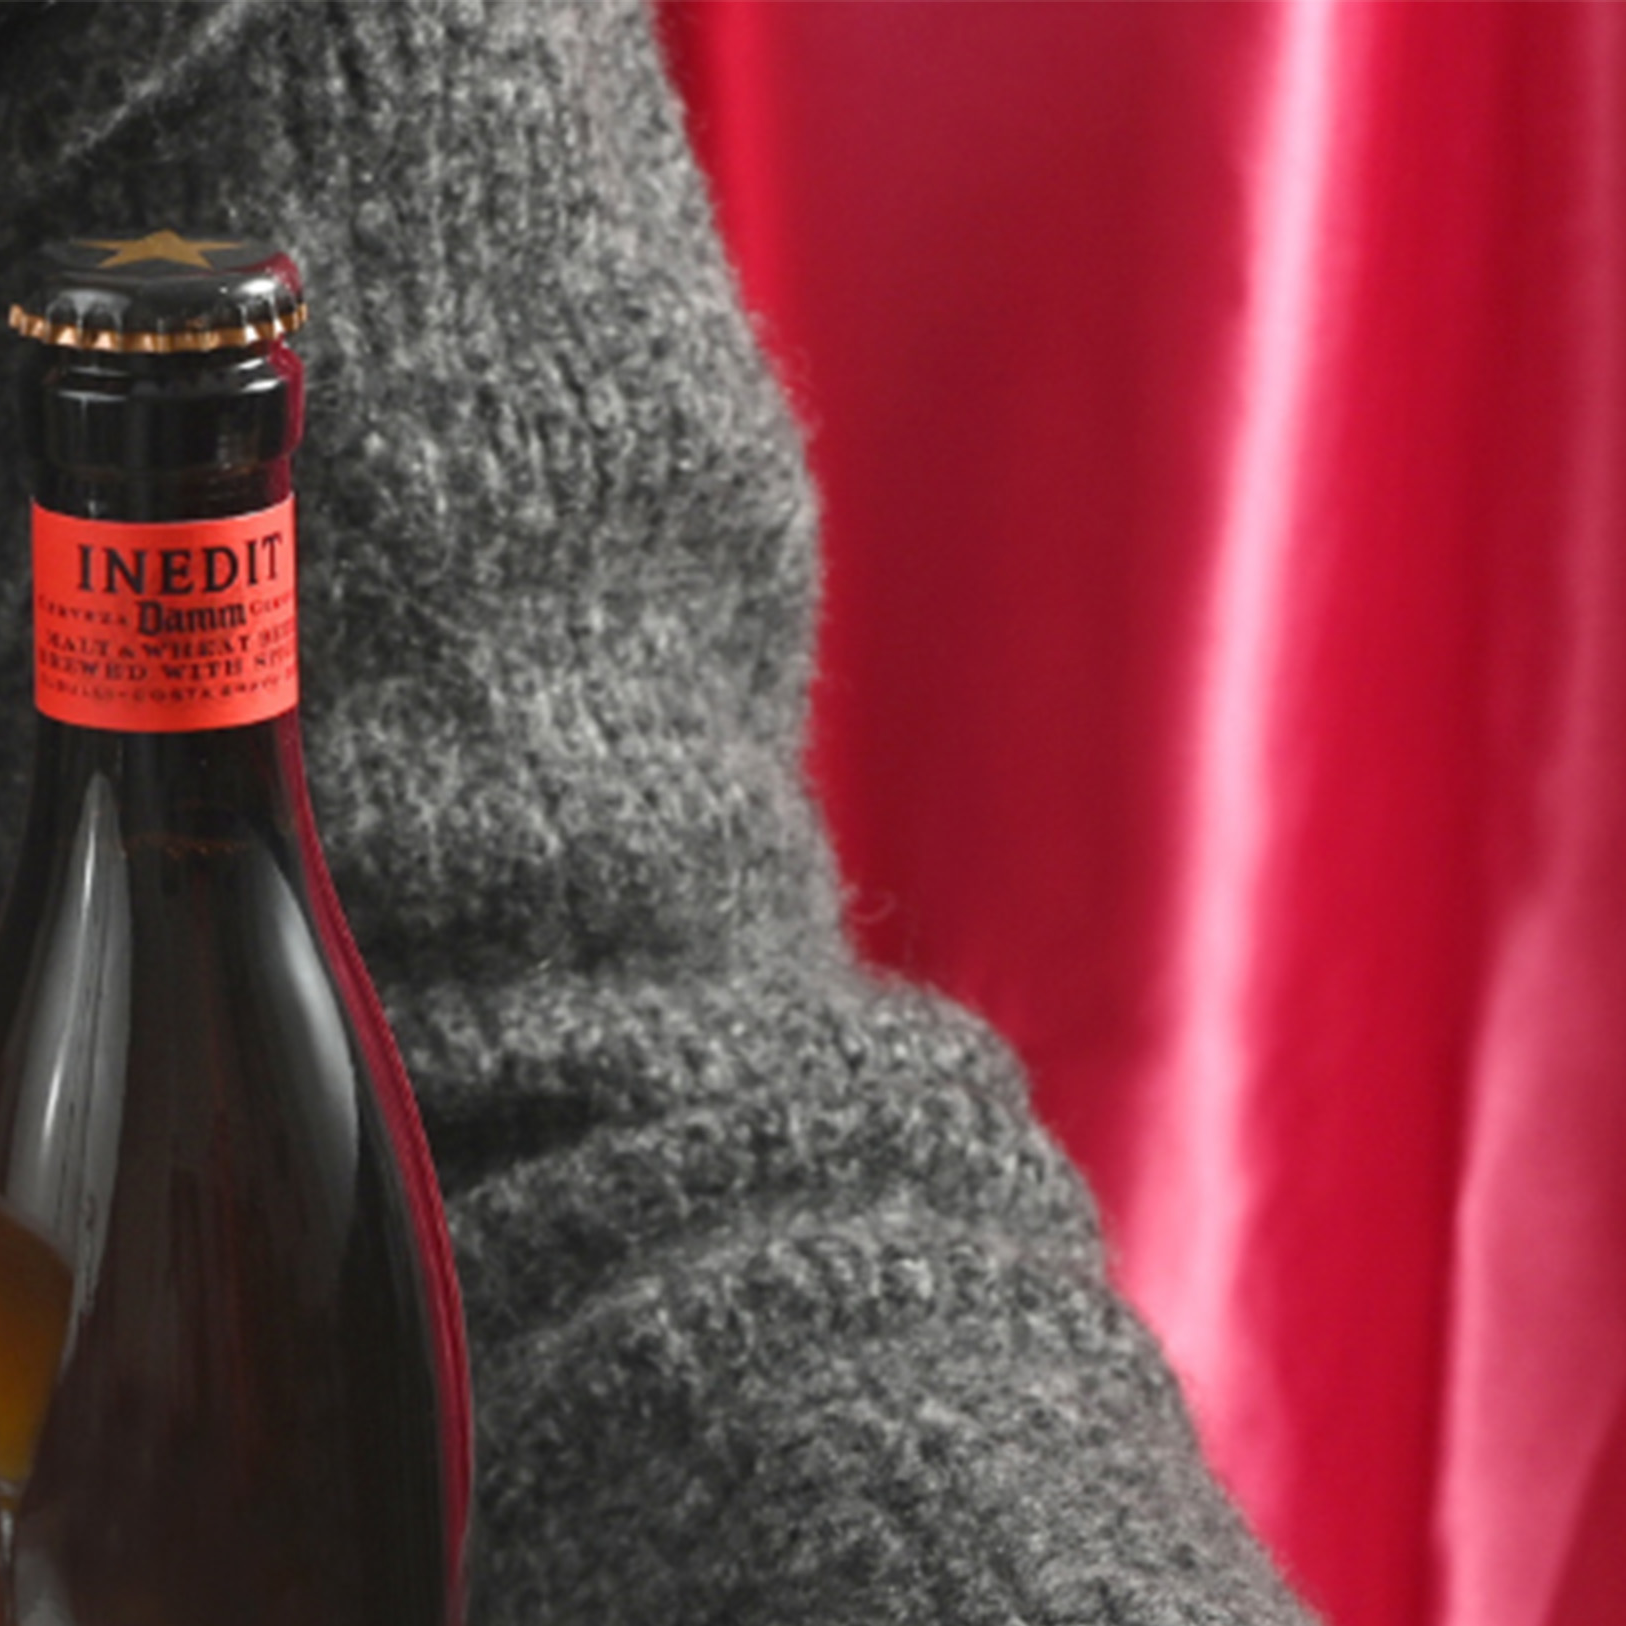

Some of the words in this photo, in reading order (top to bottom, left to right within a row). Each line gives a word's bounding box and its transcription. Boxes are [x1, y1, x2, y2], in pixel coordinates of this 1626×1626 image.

[78, 531, 283, 595] INEDIT
[135, 600, 248, 637] Damm
[141, 634, 250, 660] WHEAT
[161, 657, 244, 682] WITH
